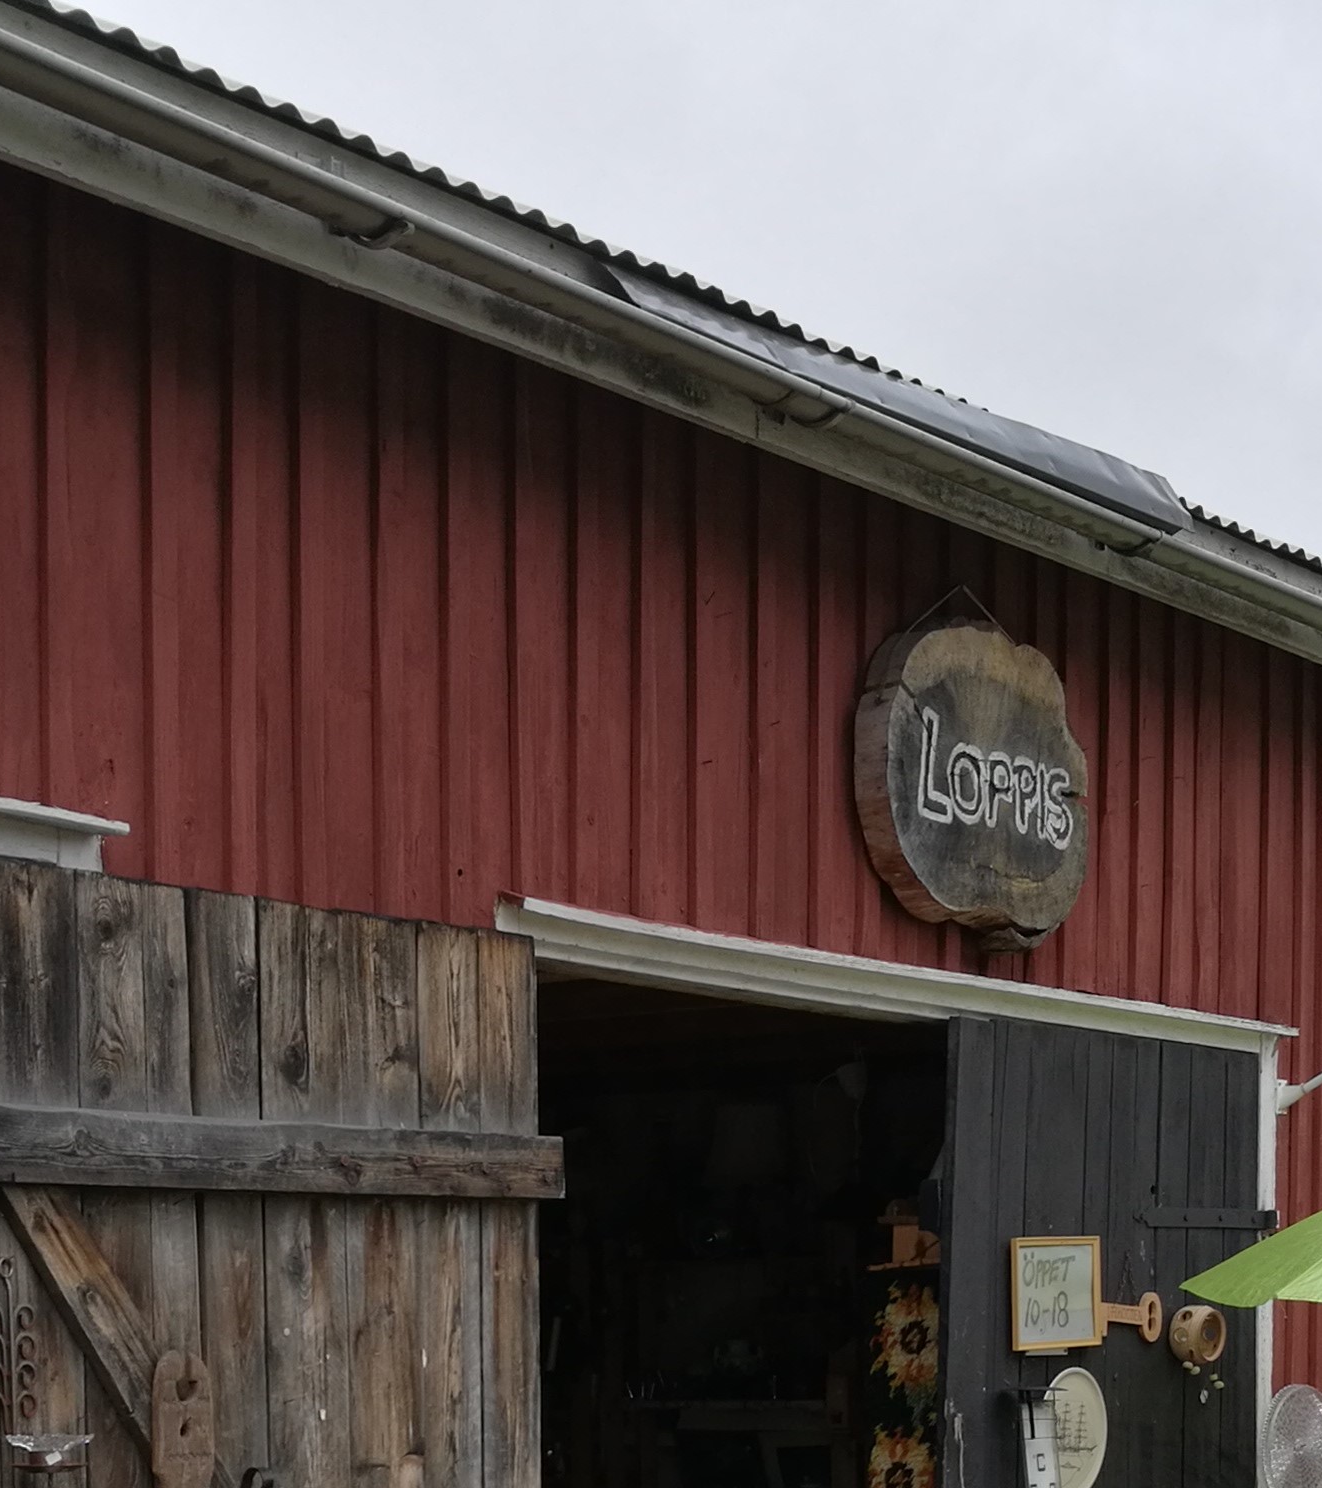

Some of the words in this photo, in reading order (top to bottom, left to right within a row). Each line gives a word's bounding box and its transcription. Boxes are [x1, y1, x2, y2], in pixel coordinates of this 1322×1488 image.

[918, 706, 1074, 851] LOPPIS
[1022, 1252, 1076, 1289] ÖPPET
[1024, 1290, 1070, 1329] 10-18
